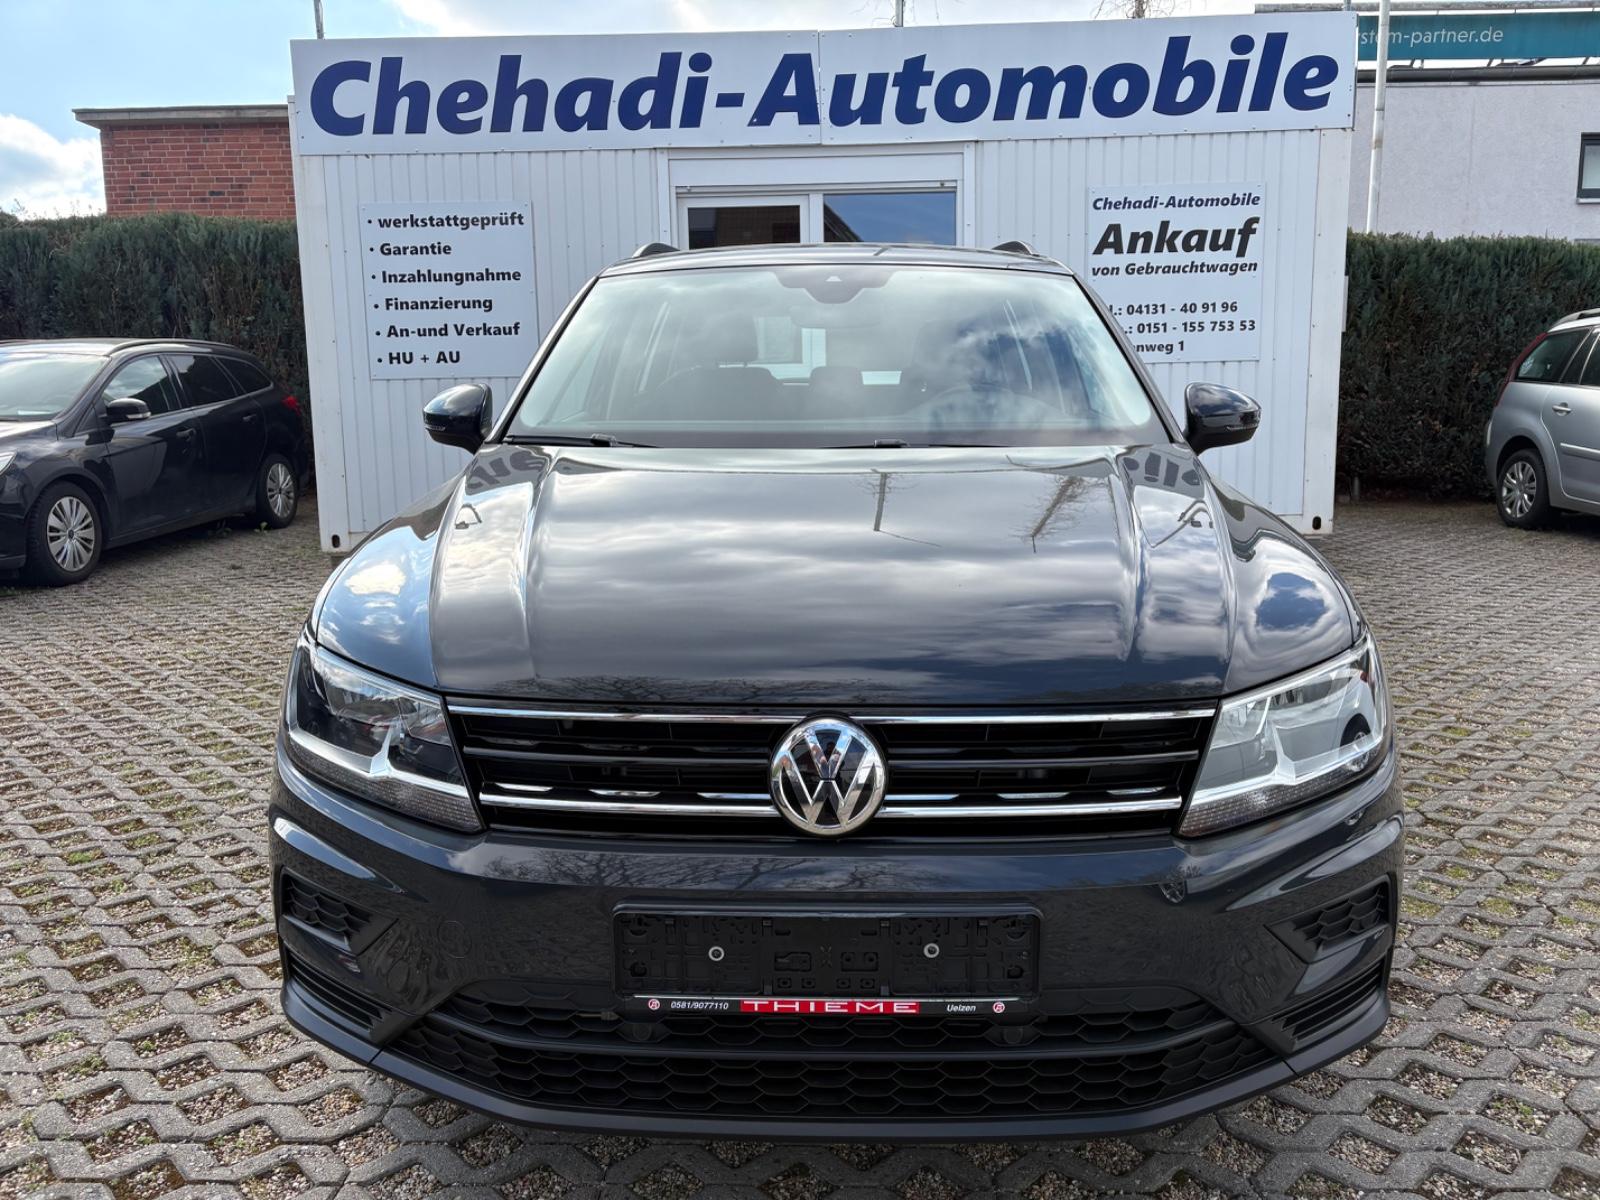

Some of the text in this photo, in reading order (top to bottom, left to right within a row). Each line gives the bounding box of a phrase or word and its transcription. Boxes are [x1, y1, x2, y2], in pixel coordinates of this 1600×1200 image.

[310, 32, 1339, 136] Chehadi-Automobile
[1092, 192, 1261, 210] Chehadi-Automobile
[378, 211, 525, 231] werkstattgeprüft
[1092, 216, 1261, 258] Ankauf
[379, 242, 452, 256] Garantie
[1091, 260, 1258, 277] von Gebrauchtwagen
[381, 268, 522, 286] Inzahlungnahme
[385, 296, 493, 313] Finanzierung
[1126, 303, 1167, 316] 04131
[1179, 302, 1198, 314] 40
[1201, 302, 1217, 314] 91
[1220, 301, 1238, 313] 96
[386, 322, 521, 338] An-und Verkauf
[1136, 322, 1168, 334] 0151
[1181, 321, 1205, 333] 155
[1210, 320, 1235, 332] 753
[1239, 320, 1256, 331] 53
[1133, 340, 1184, 355] nweg 1
[388, 351, 461, 365] HU + AU
[670, 1001, 729, 1010] 0581/9077110
[743, 1001, 917, 1013] THIEME
[946, 1003, 977, 1013] Uelzen
